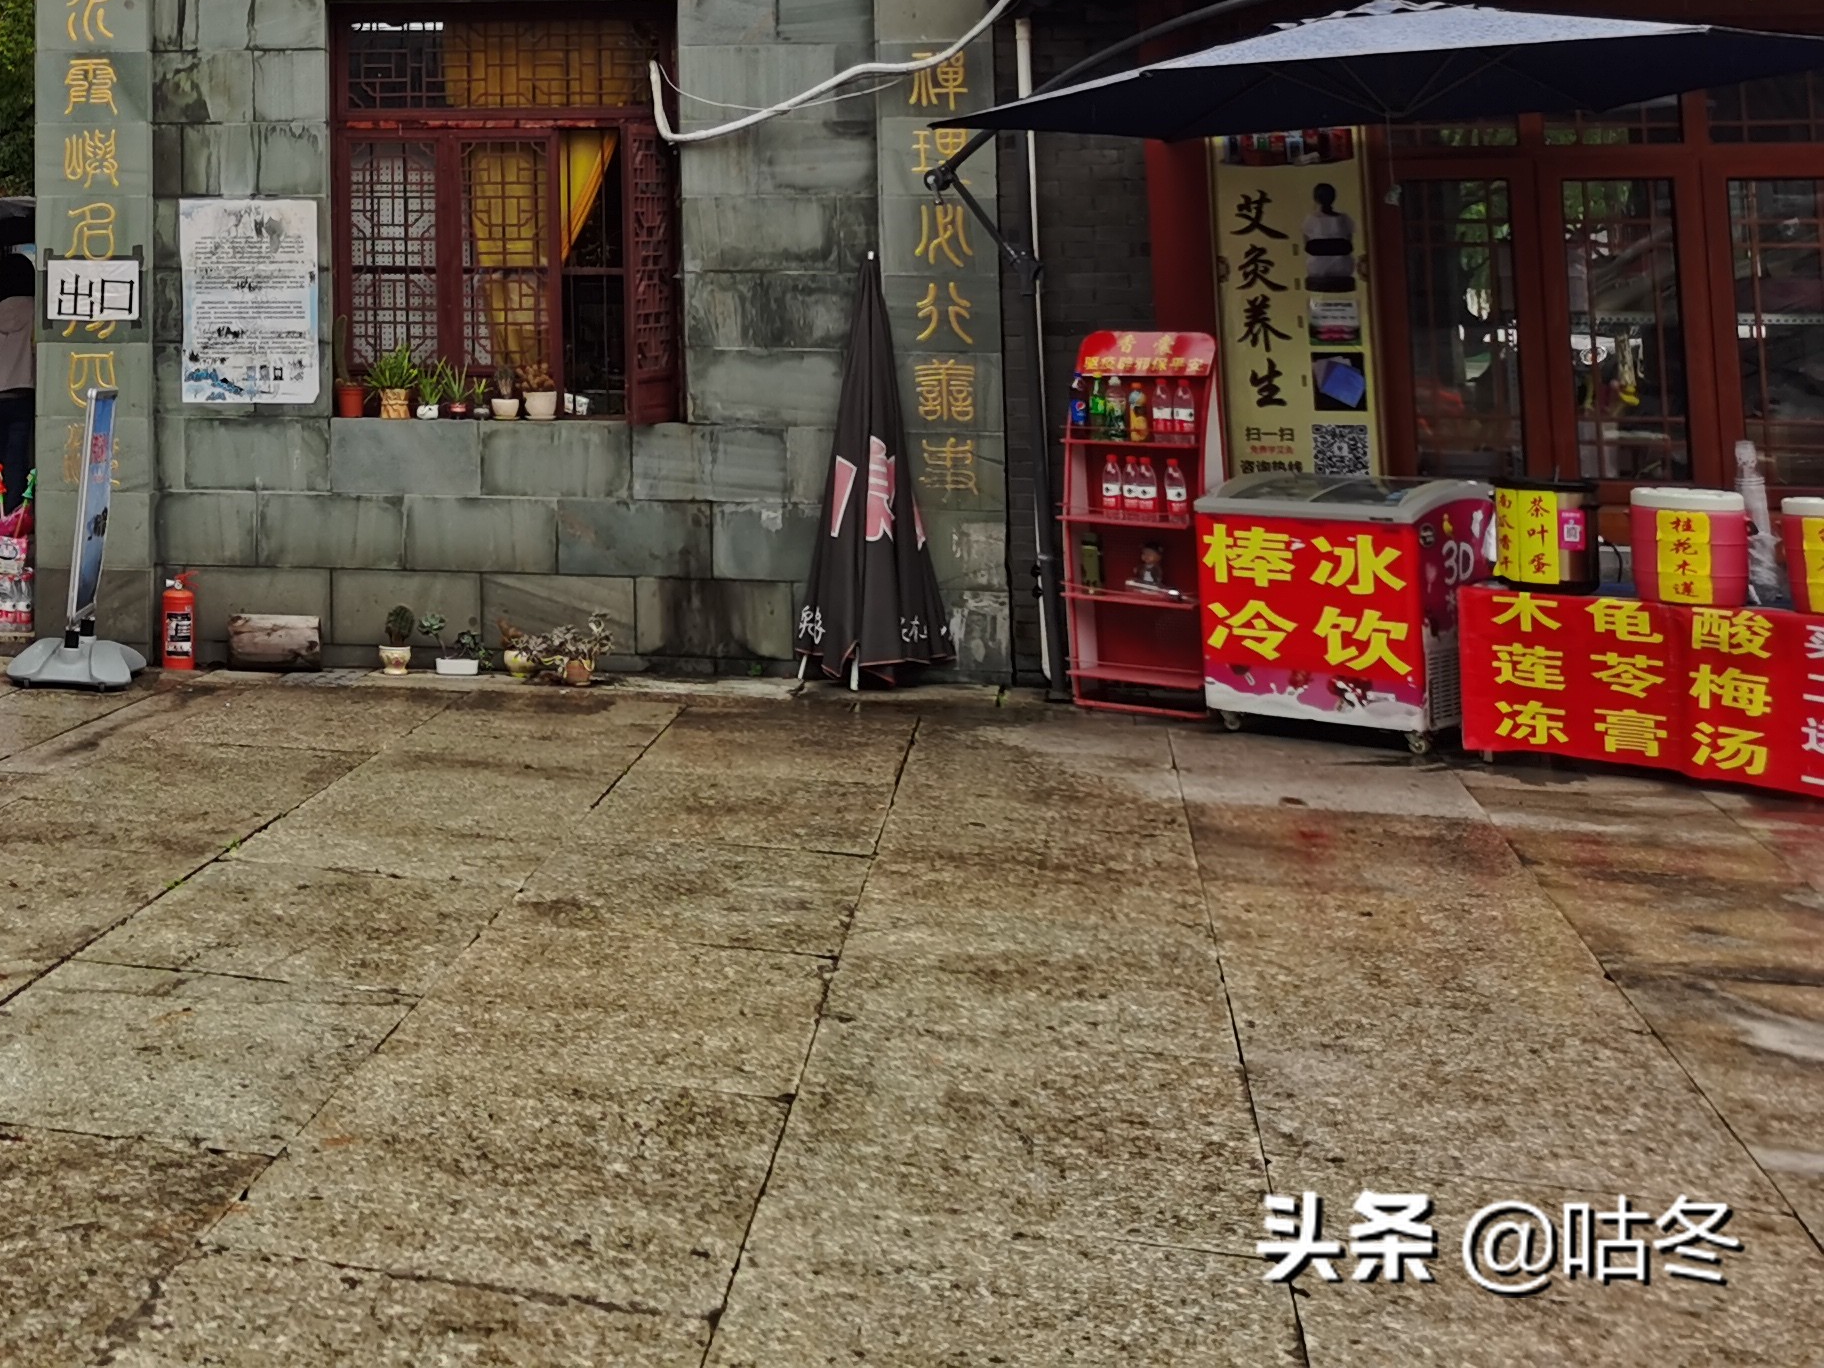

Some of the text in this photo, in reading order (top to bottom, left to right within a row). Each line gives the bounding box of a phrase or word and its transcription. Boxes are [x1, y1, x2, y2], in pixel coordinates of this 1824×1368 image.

[56, 273, 135, 319] 出口
[1228, 188, 1292, 409] 艾灸养生
[1245, 426, 1295, 443] 扫一扫
[1202, 522, 1408, 595] 棒冰
[1442, 539, 1475, 586] 3D
[1527, 495, 1553, 576] 茶叶蛋
[1206, 598, 1414, 676] 冷饮
[1490, 592, 1570, 746] 木莲冻
[1584, 598, 1668, 758] 龟苓膏
[1688, 606, 1774, 776] 酸梅汤
